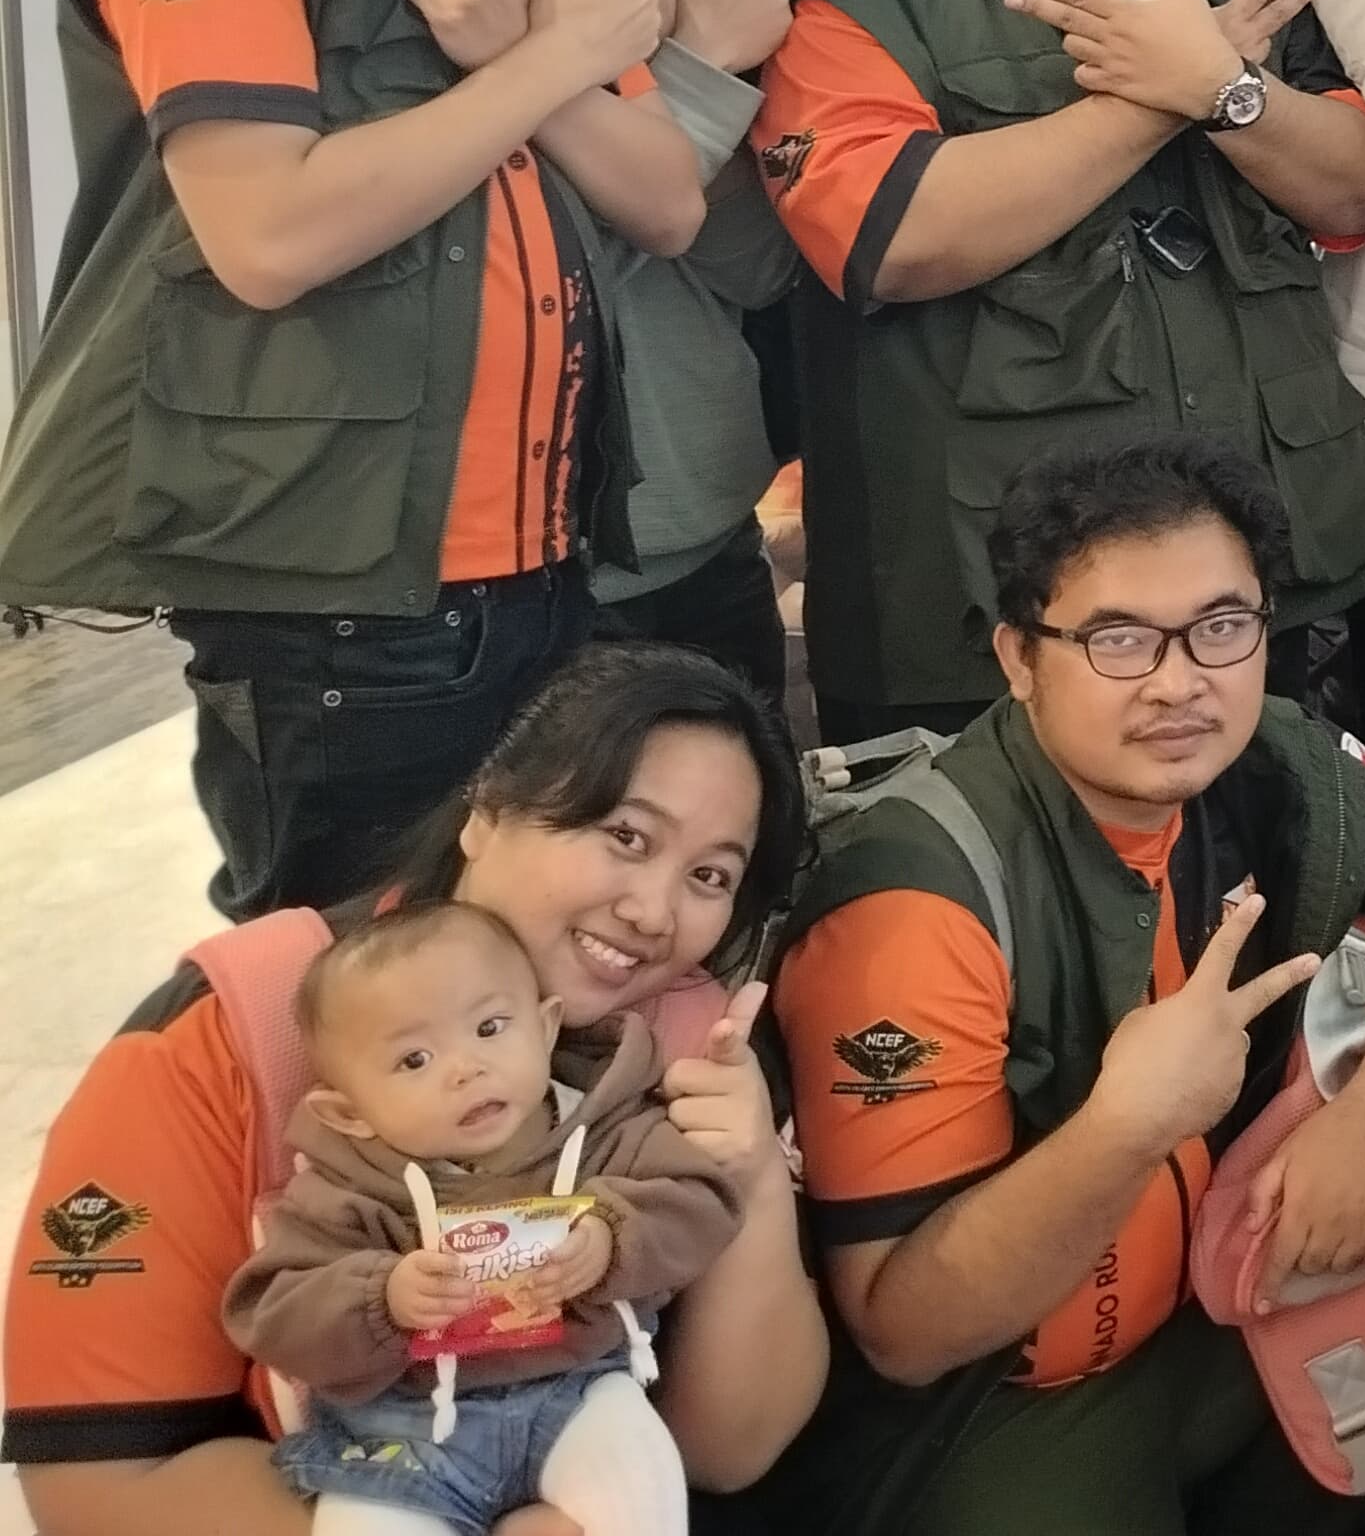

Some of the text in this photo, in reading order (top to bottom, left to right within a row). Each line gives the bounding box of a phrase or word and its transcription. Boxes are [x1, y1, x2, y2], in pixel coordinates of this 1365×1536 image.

[865, 1033, 906, 1048] NCEF
[68, 1197, 109, 1216] NCEF
[452, 1230, 501, 1250] Roma
[464, 1251, 550, 1284] alkist
